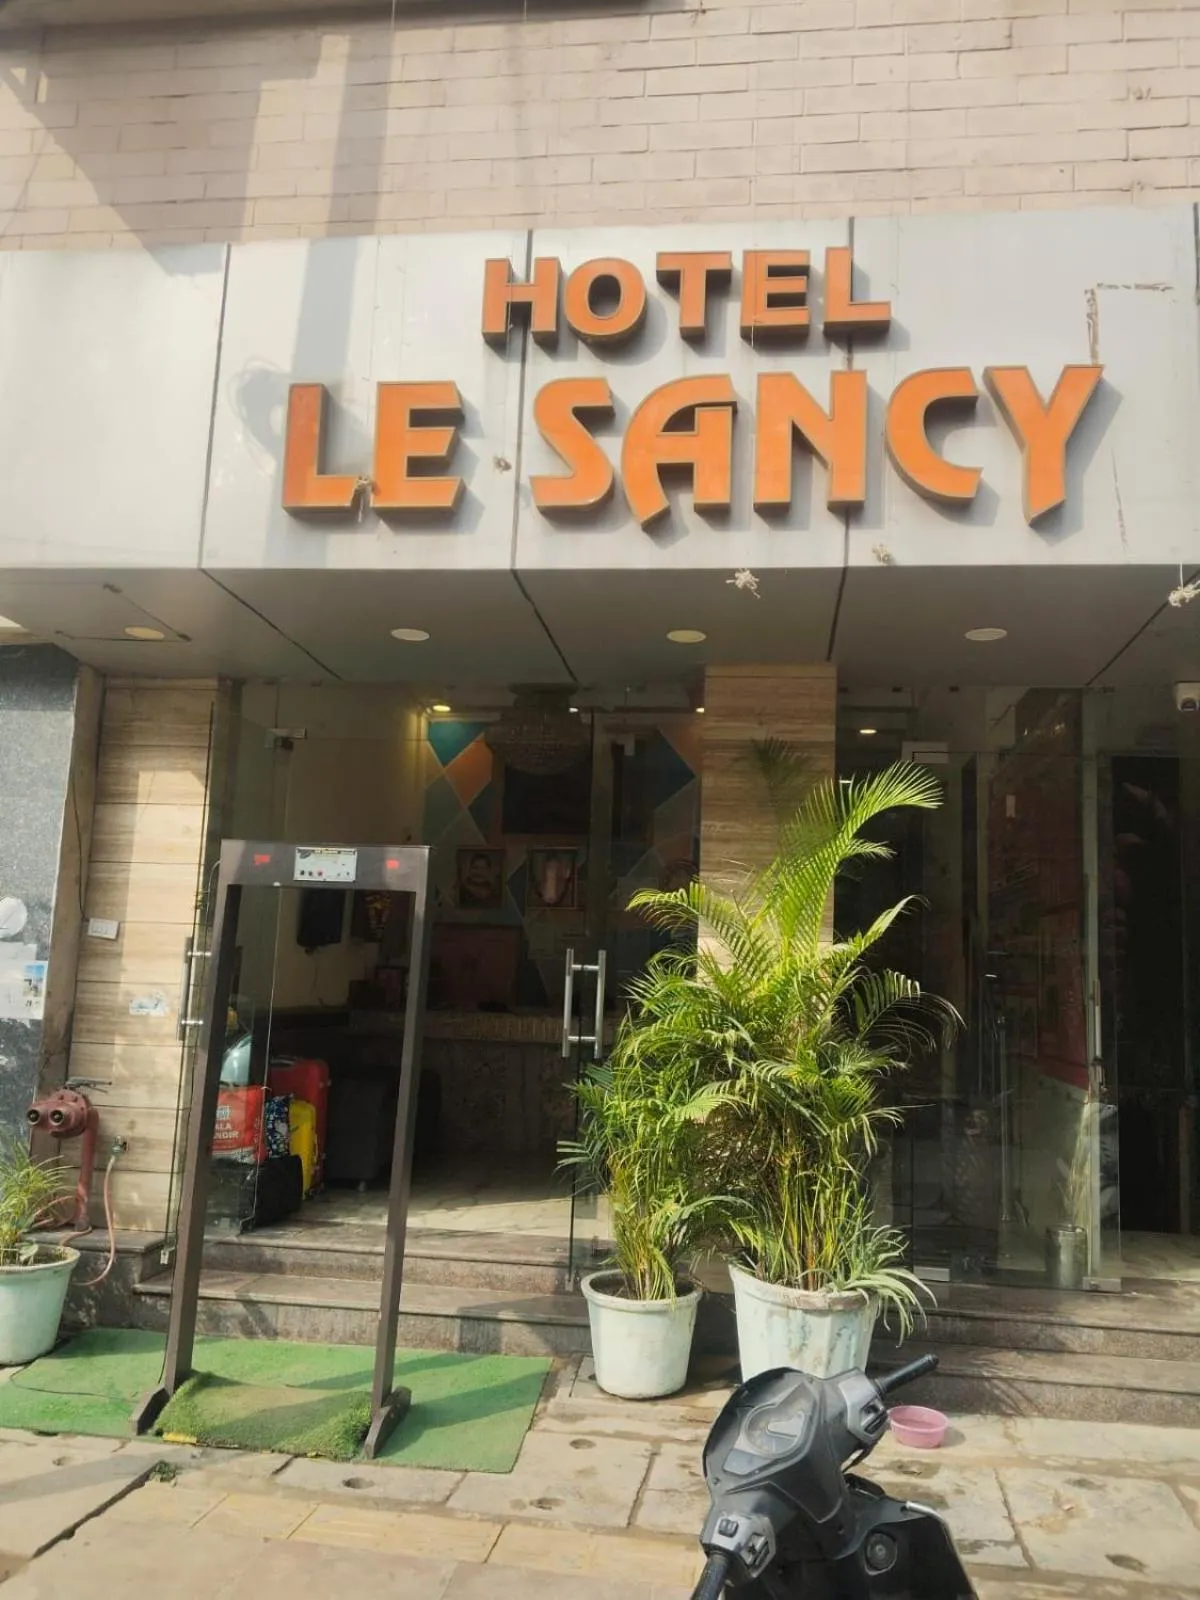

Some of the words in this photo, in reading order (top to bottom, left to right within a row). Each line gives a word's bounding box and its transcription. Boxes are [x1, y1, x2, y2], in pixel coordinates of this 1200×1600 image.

[482, 246, 891, 347] HOTEL
[282, 380, 465, 514] LE
[529, 364, 1105, 528] SANCY
